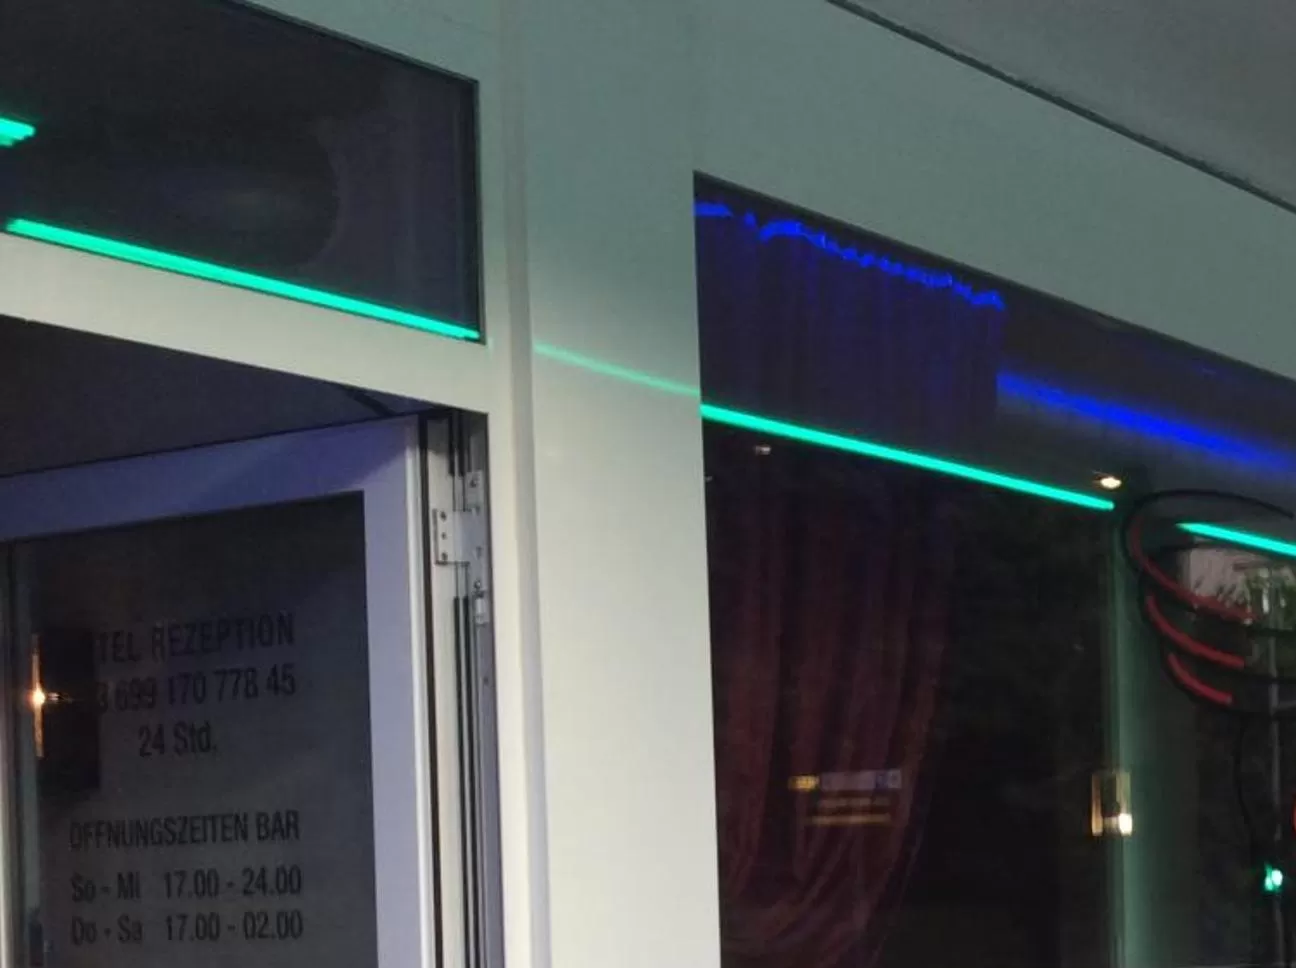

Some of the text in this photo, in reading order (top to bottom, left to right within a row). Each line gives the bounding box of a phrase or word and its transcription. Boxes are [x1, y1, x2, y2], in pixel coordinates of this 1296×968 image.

[98, 613, 295, 665] TEL REZEPTION
[167, 670, 208, 705] 170
[265, 661, 297, 697] 45
[138, 719, 217, 758] 24 Std.
[255, 809, 301, 843] BAR
[69, 870, 97, 903] So
[163, 867, 221, 900] 17.00
[241, 863, 303, 897] 24.00
[71, 914, 98, 946] Do
[116, 912, 144, 944] Sa
[165, 911, 221, 942] 17.00
[242, 908, 304, 941] 02.00
